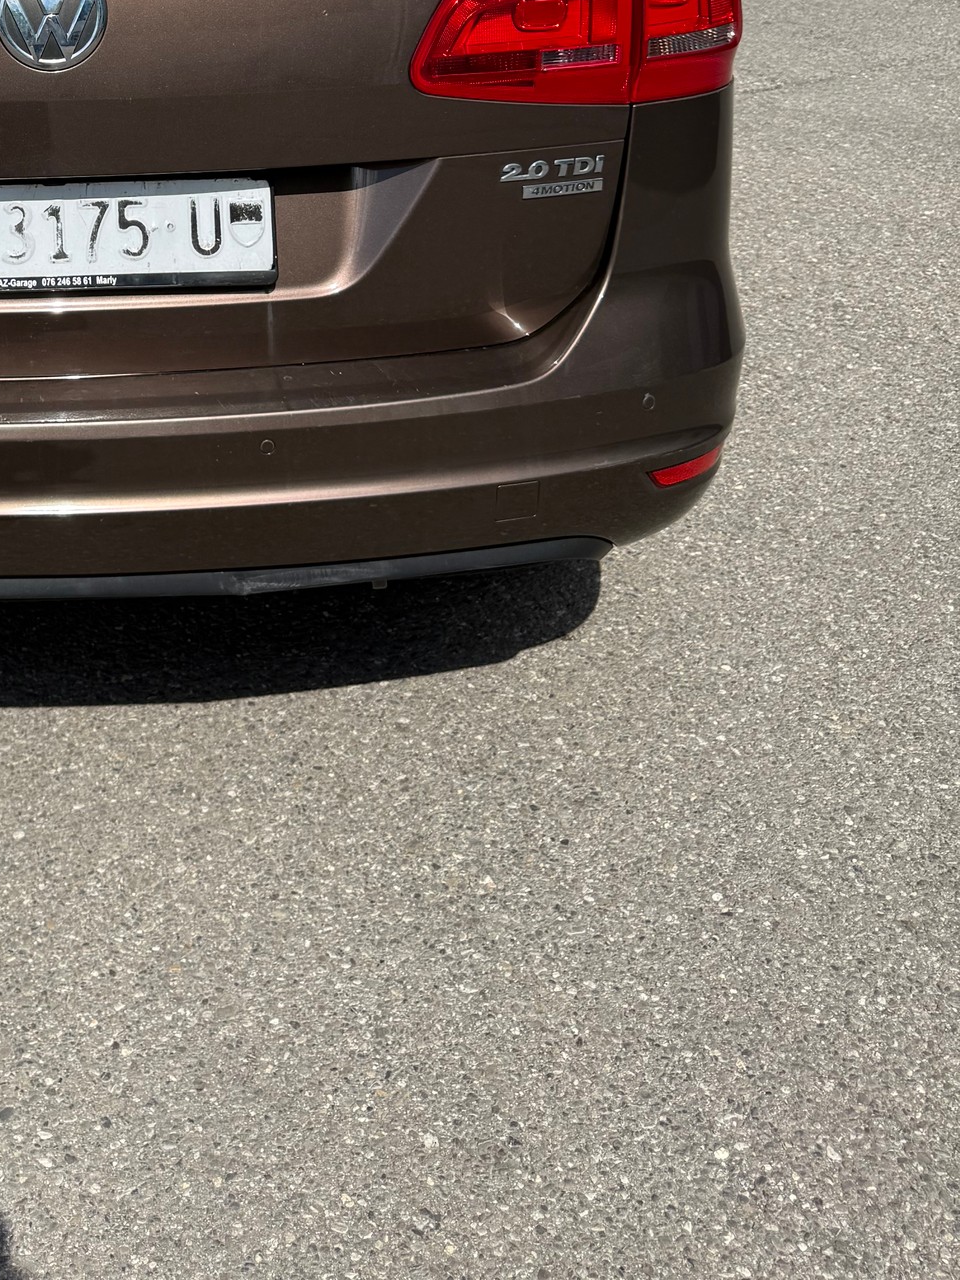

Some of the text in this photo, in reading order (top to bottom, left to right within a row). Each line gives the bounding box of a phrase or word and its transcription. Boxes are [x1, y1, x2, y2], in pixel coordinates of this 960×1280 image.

[531, 182, 594, 195] 4MOTION
[3, 198, 151, 264] 3175
[189, 196, 222, 258] U
[41, 277, 56, 287] 076
[57, 277, 71, 286] 246
[72, 276, 82, 285] 58
[83, 276, 92, 285] 61
[96, 275, 117, 286] Marly
